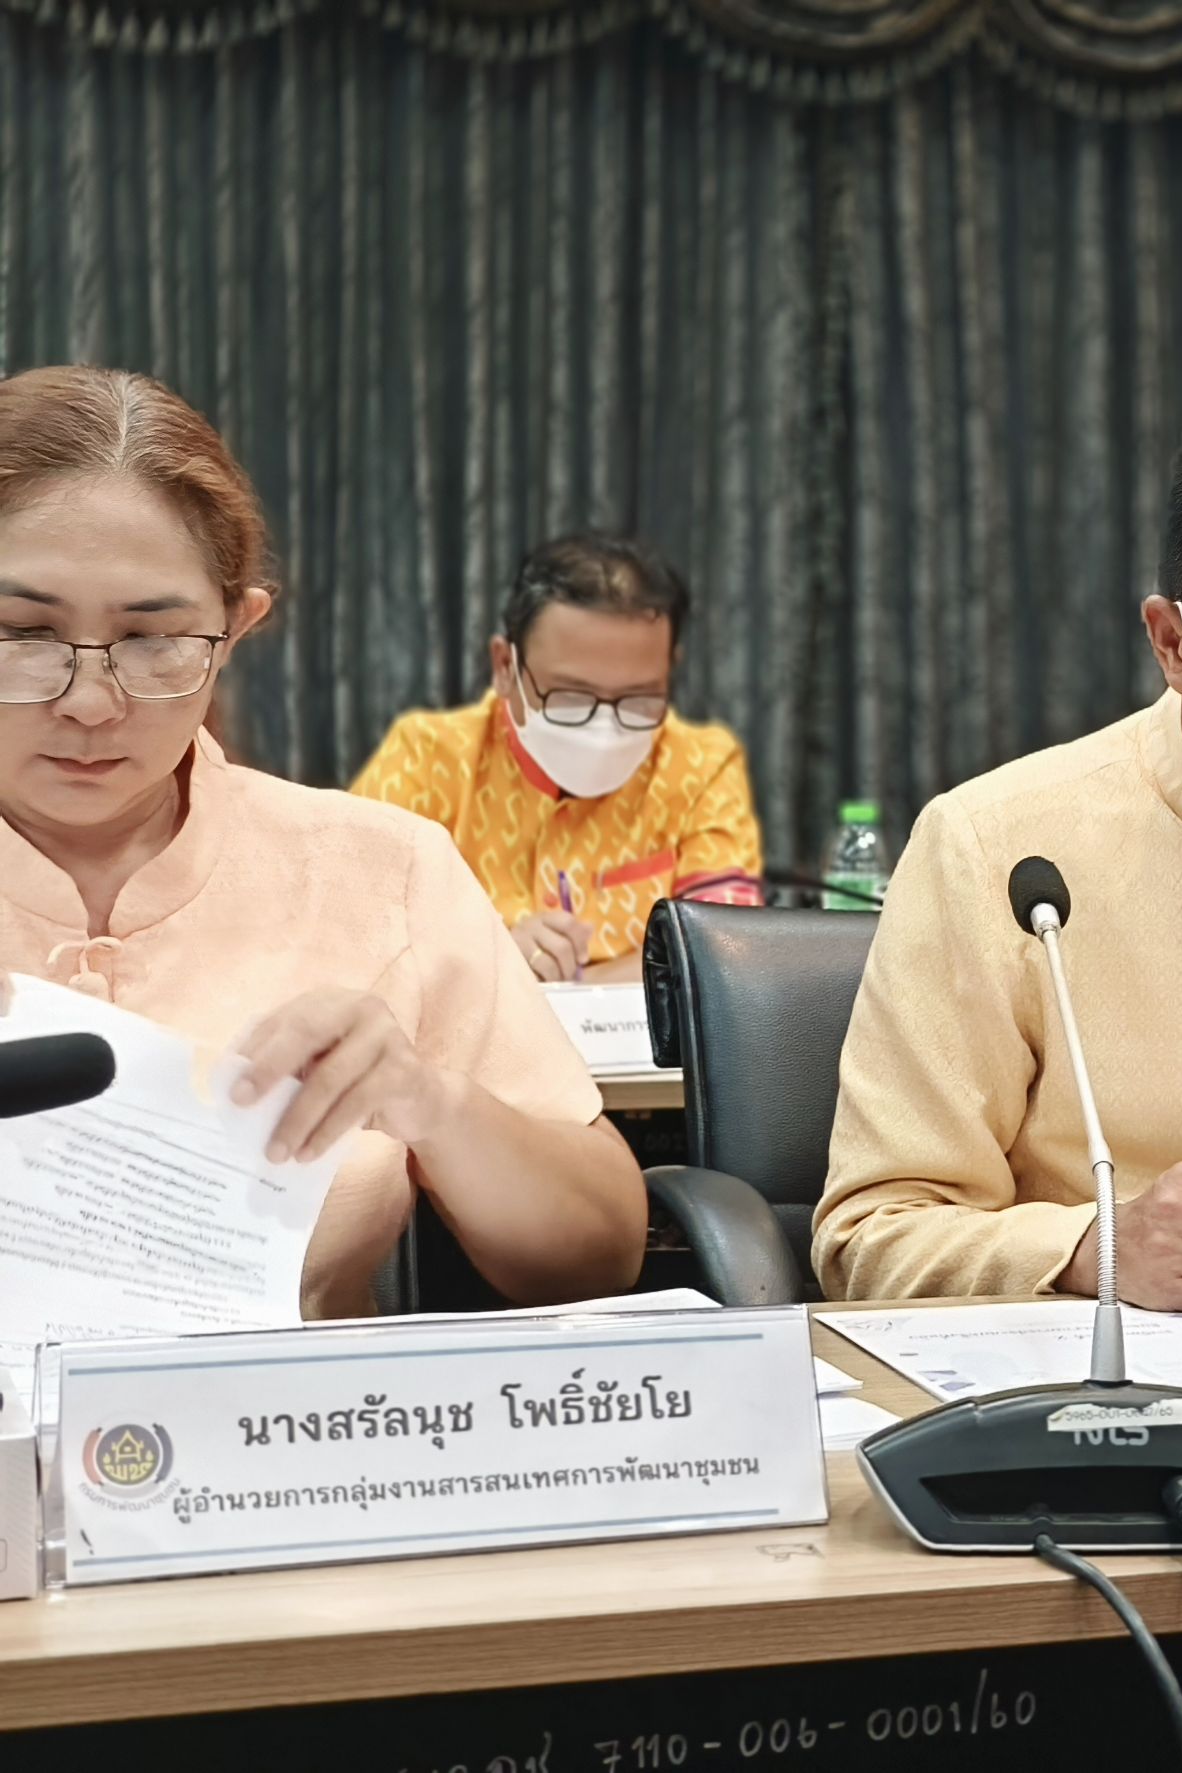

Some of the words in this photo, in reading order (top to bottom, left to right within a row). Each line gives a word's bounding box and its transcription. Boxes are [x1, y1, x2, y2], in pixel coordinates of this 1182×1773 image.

[580, 1018, 648, 1034] พัฒนากา
[238, 1394, 474, 1450] นางสรัลนุช
[500, 1367, 692, 1429] โพธิ์ชัยโย
[172, 1456, 760, 1524] ผู้อำนวยการกลุ่มงานสารสนเทศการพัฒนาชุมชน
